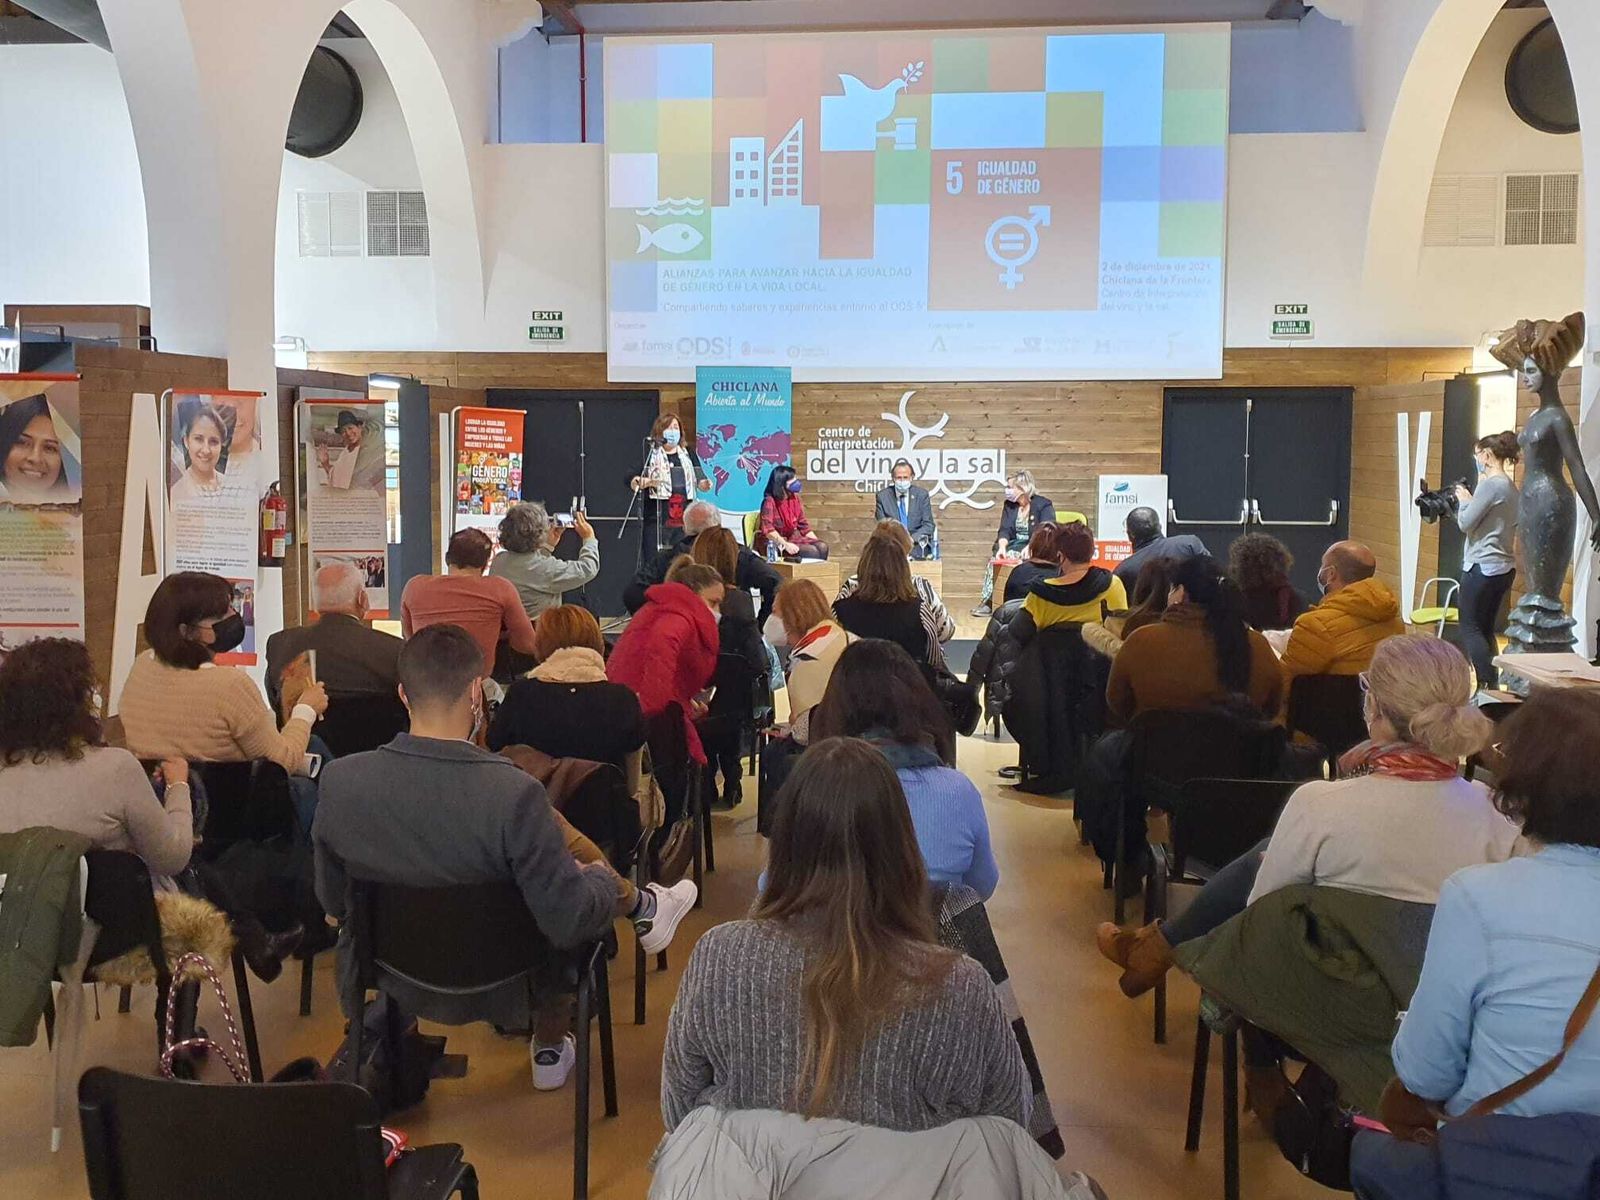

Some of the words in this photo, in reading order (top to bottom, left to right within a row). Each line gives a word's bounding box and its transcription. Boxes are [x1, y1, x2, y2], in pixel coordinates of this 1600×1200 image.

[977, 160, 1037, 176] IGUALDAD
[946, 160, 963, 194] 5
[978, 179, 992, 194] DE
[994, 177, 1040, 194] GÉNERO
[662, 269, 714, 279] ALIANZAS
[718, 268, 747, 279] PARA
[750, 267, 801, 278] AVANZAR
[803, 266, 836, 278] HACIA
[839, 266, 853, 277] LA
[856, 266, 912, 278] IGUALDAD
[663, 282, 676, 292] DE
[727, 282, 743, 292] EN
[745, 282, 760, 292] LA
[761, 281, 786, 292] VIDA
[1276, 305, 1306, 314] EXIT
[534, 312, 561, 320] EXIT
[676, 337, 725, 356] ODS
[712, 382, 779, 392] CHICLANA
[704, 392, 737, 406] Abierta
[740, 393, 753, 406] al
[753, 392, 785, 406] Mundo
[818, 427, 854, 438] Centro
[858, 426, 871, 438] de
[818, 437, 895, 449] Interpretación
[810, 446, 846, 474] del
[916, 457, 931, 481] y
[939, 448, 958, 474] la
[968, 449, 1001, 474] sal
[1105, 492, 1138, 504] famsi
[1104, 545, 1131, 553] IGUALDAD
[1104, 553, 1112, 561] DE
